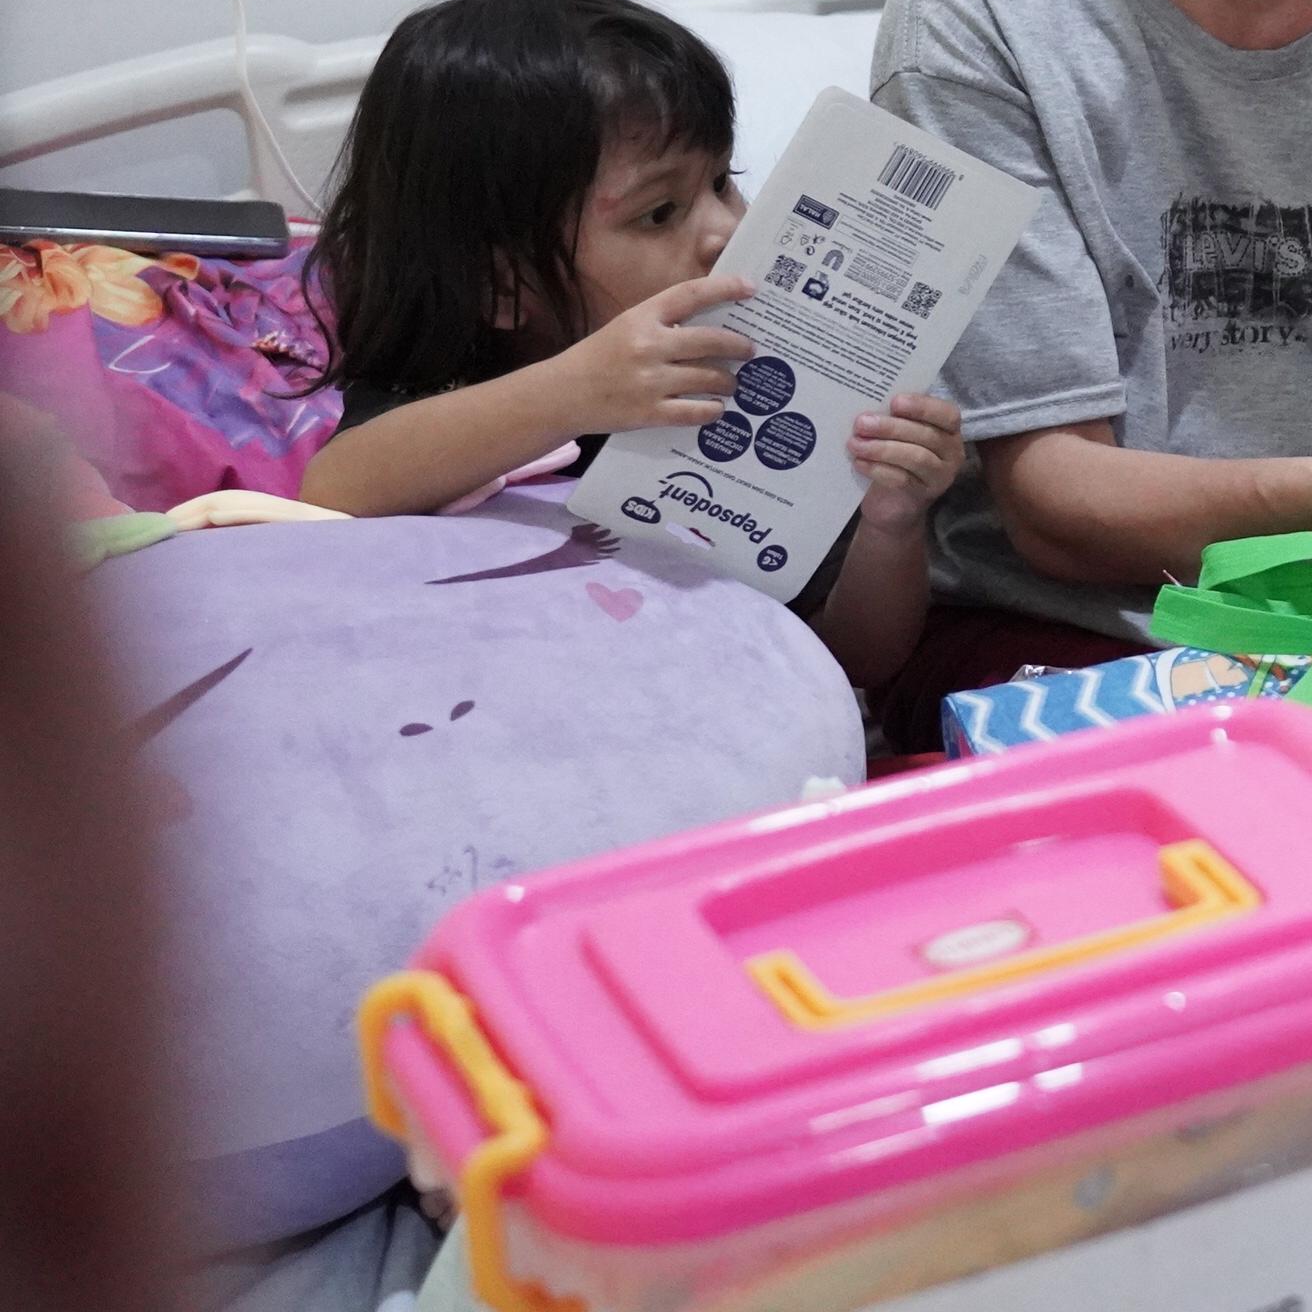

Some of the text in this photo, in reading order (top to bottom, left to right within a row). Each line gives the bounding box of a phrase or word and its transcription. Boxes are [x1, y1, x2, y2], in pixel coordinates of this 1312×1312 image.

[799, 203, 820, 218] HALAL
[621, 499, 656, 520] KIDS
[657, 482, 772, 544] Pepsodent
